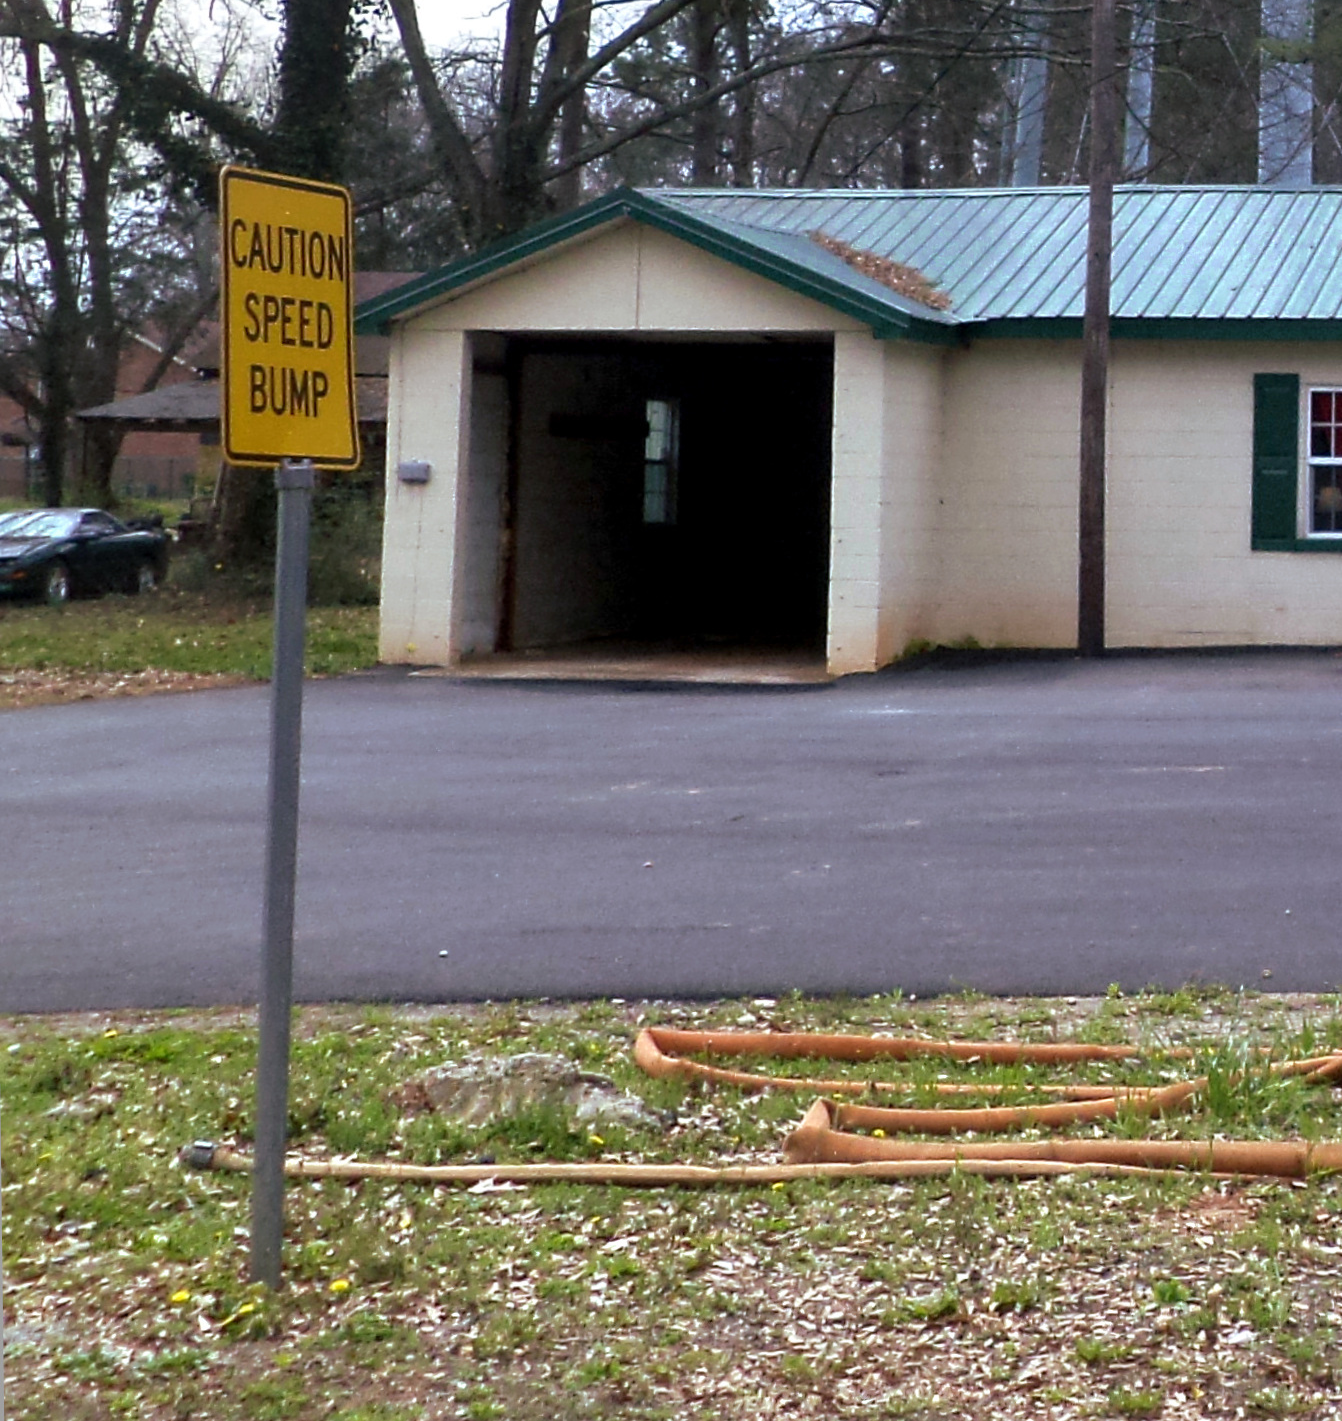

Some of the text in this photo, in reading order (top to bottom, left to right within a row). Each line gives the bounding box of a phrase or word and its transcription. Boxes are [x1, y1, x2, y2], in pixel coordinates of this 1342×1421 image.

[230, 217, 344, 282] CAUTION
[243, 292, 333, 349] SPEED
[249, 364, 329, 418] BUMP
